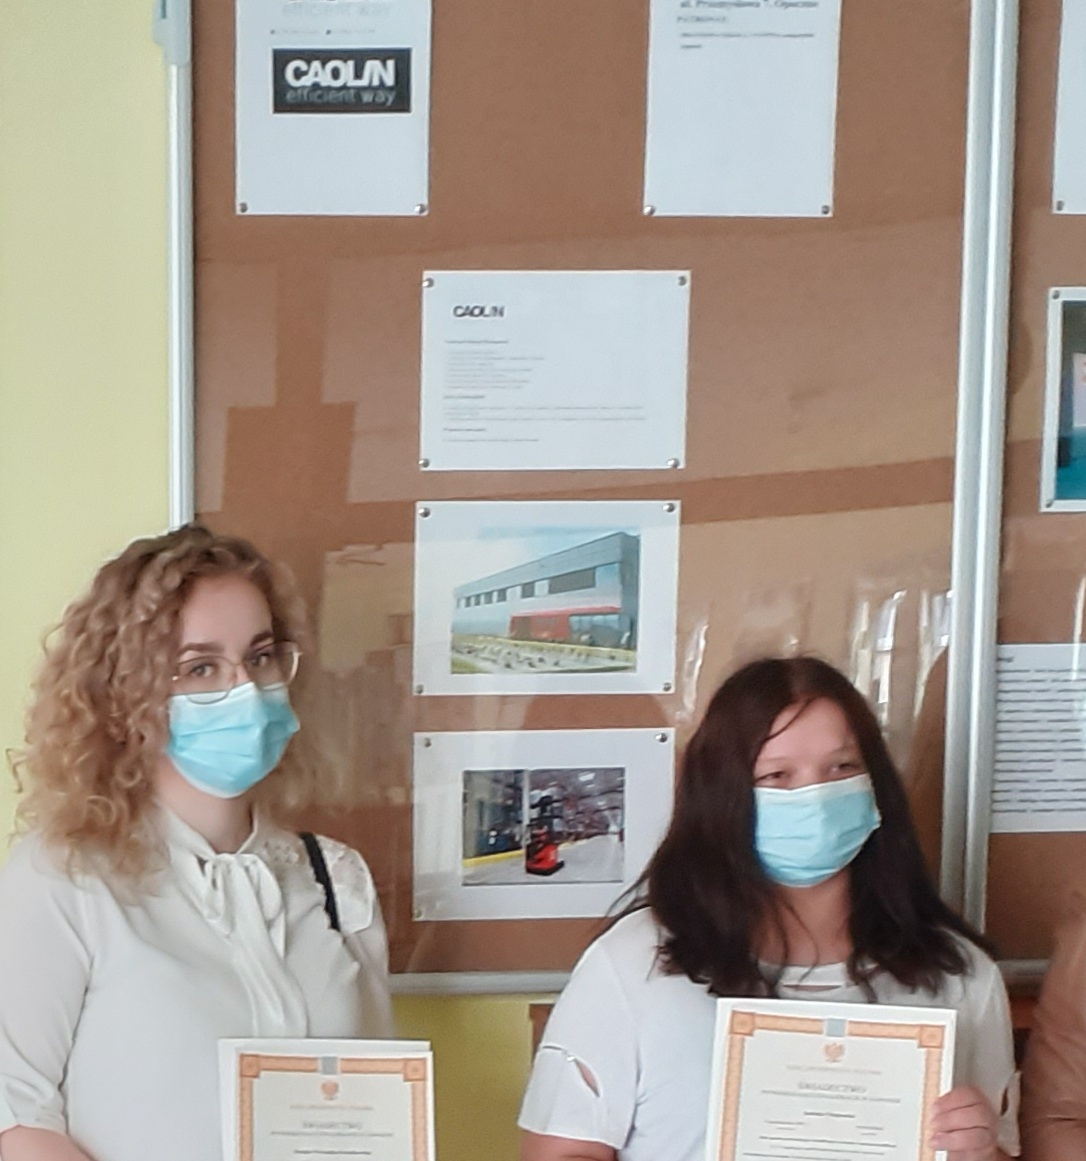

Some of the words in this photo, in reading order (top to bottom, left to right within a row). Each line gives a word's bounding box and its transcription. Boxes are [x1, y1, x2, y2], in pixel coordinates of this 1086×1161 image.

[284, 58, 396, 88] CAOLIN
[286, 88, 355, 104] efficient
[360, 90, 396, 106] way
[453, 305, 505, 318] CAOLIN
